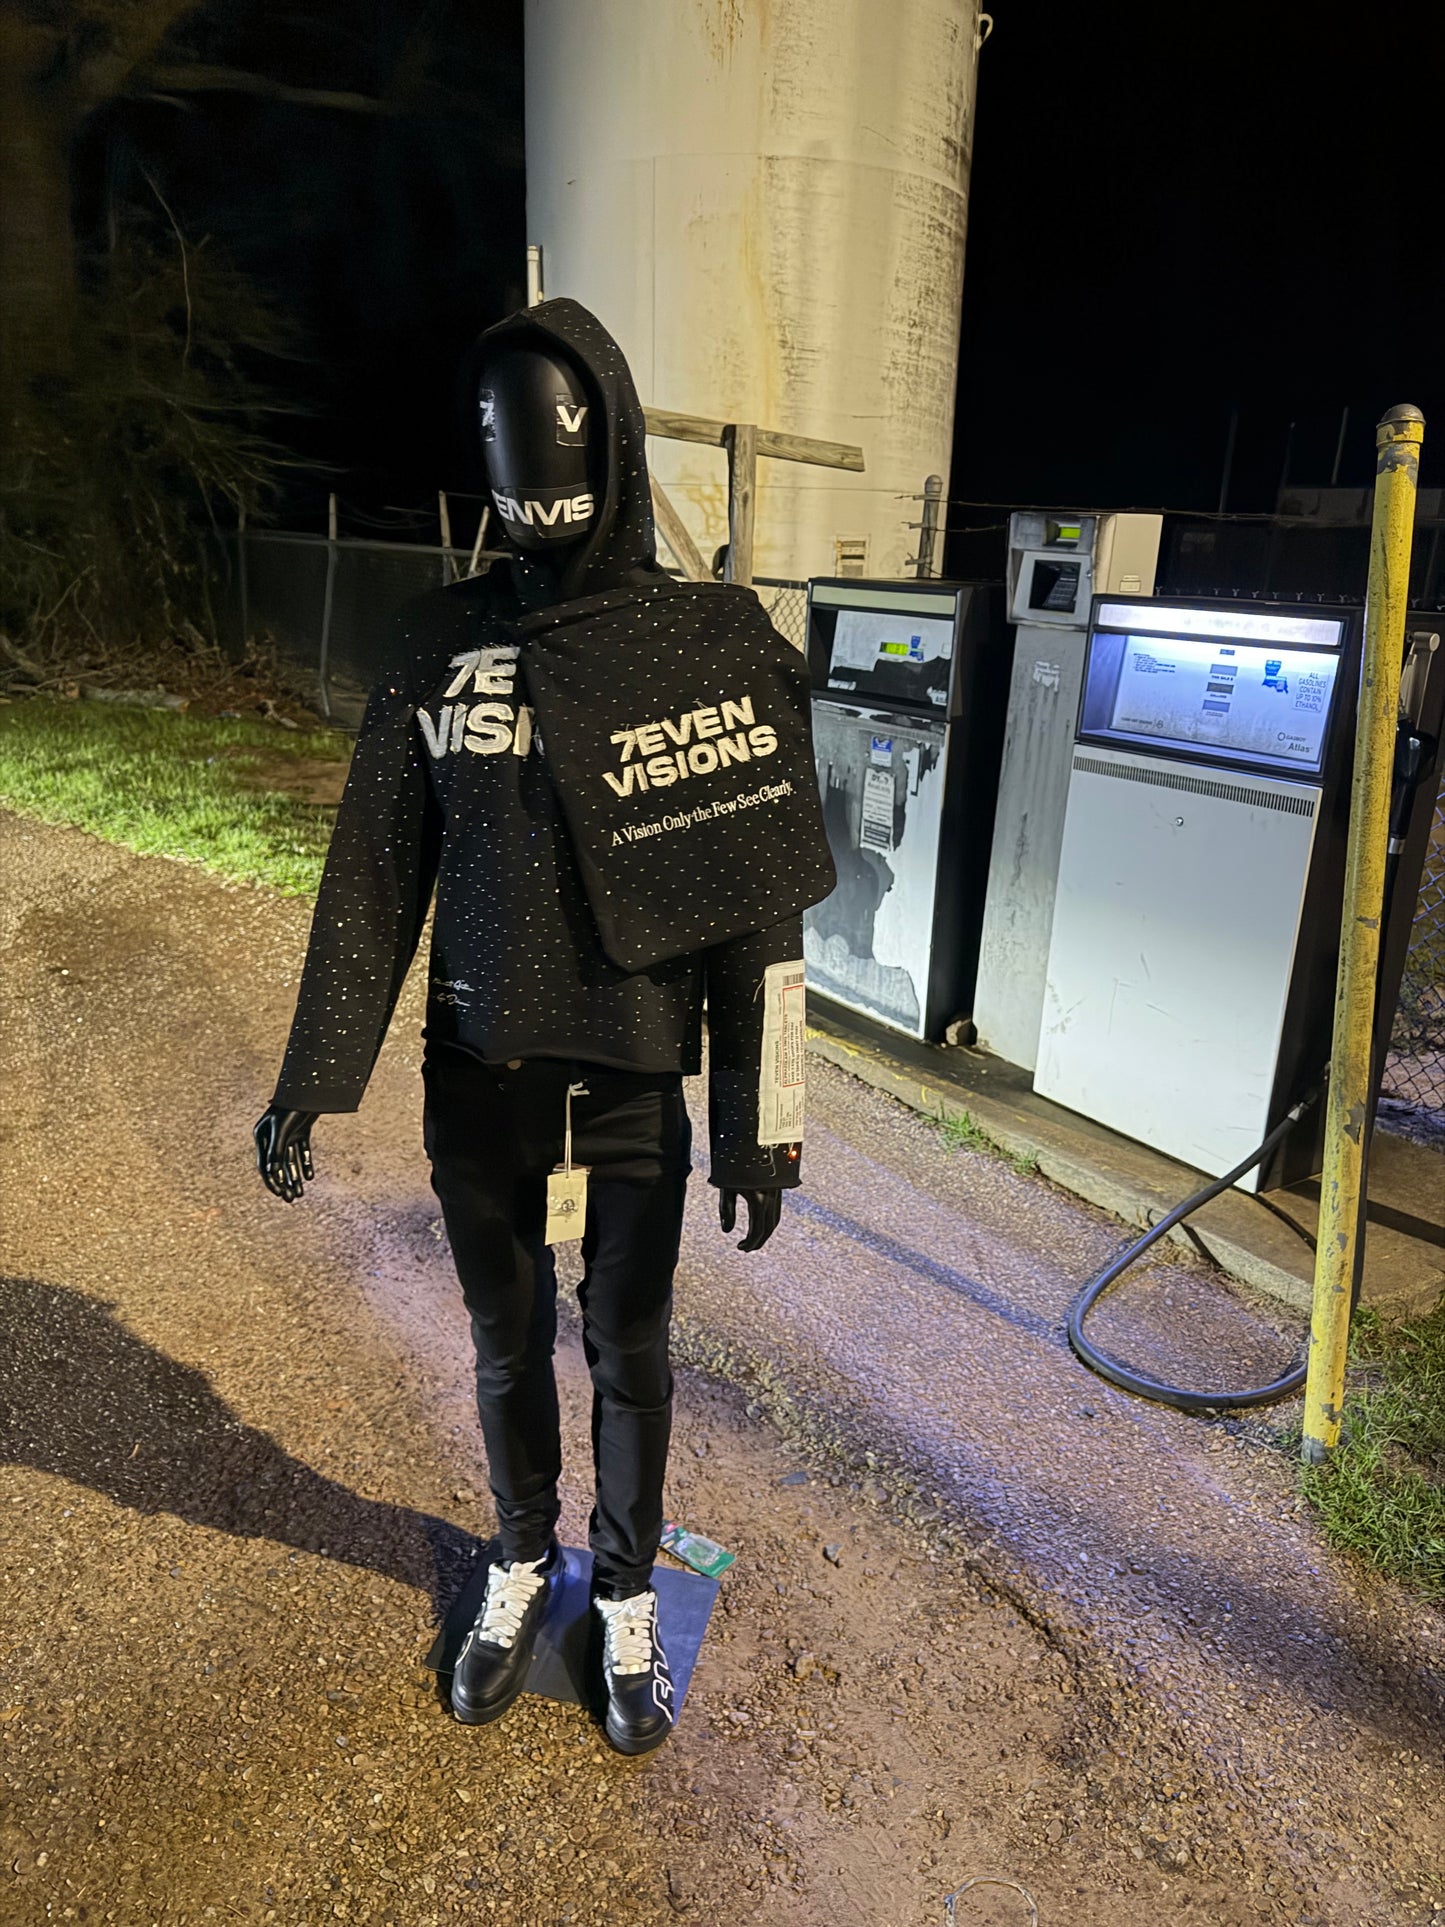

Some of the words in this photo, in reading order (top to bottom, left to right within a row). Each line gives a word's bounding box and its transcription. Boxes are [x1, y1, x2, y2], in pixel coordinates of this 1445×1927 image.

[556, 405, 588, 432] V
[443, 645, 520, 698] 7E
[416, 703, 545, 759] VISI
[610, 696, 755, 762] 7EVEN
[1288, 743, 1311, 753] Atlas
[602, 725, 778, 797] VISIONS
[611, 831, 624, 847] A
[621, 822, 663, 842] Vision
[662, 811, 692, 829] Only
[691, 807, 713, 823] the
[711, 801, 738, 817] Few
[736, 793, 760, 809] See
